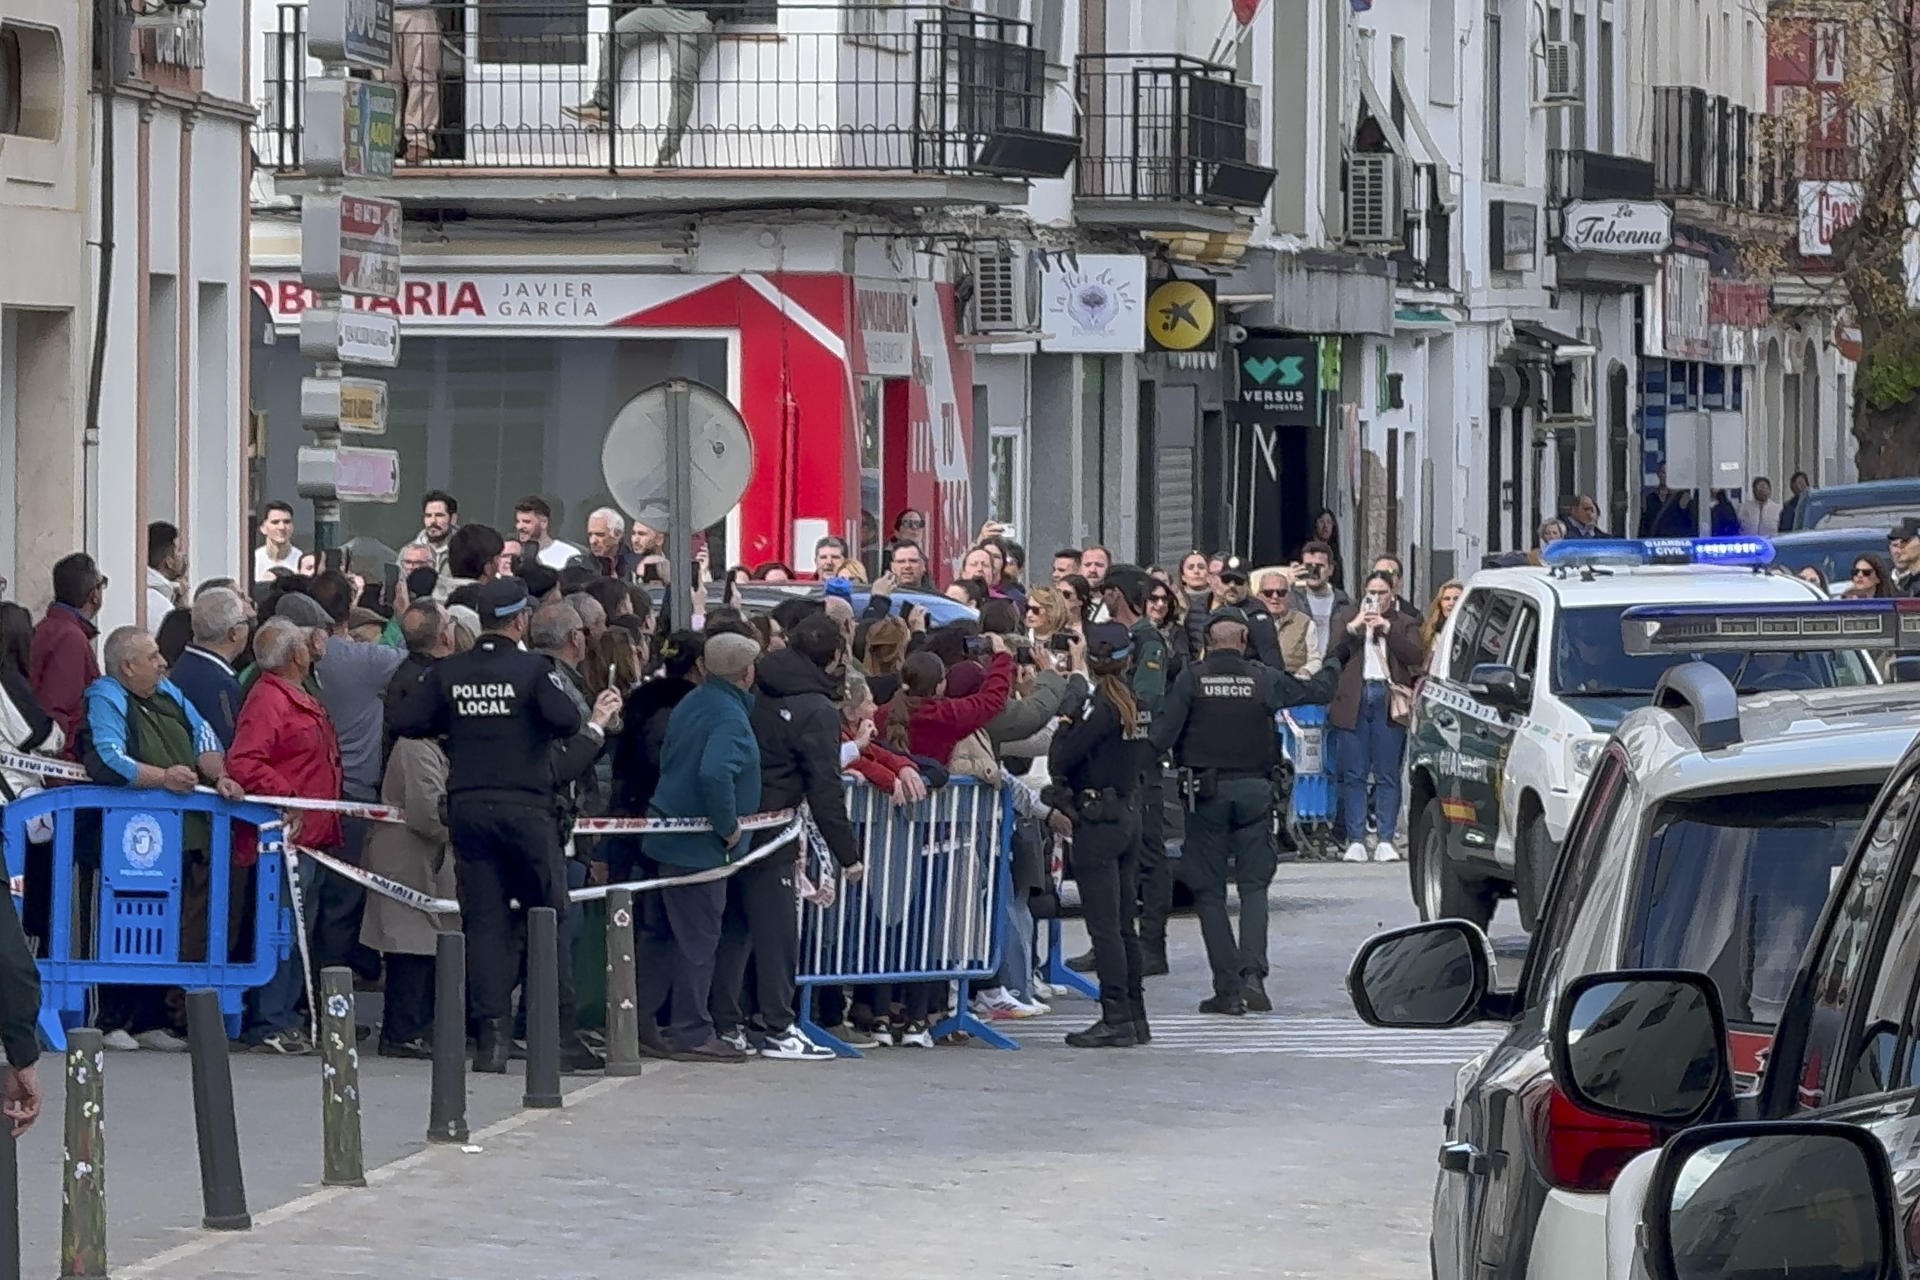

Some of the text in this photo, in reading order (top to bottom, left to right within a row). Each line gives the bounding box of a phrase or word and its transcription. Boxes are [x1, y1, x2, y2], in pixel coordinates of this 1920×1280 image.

[1612, 203, 1634, 218] La
[1574, 216, 1662, 245] Tabenna
[502, 282, 593, 298] JAVIER
[498, 297, 598, 317] GARCÍA
[1243, 389, 1304, 402] VERSUS
[451, 683, 517, 699] POLICIA
[1204, 685, 1252, 697] USECIC
[457, 699, 511, 716] LOCAL
